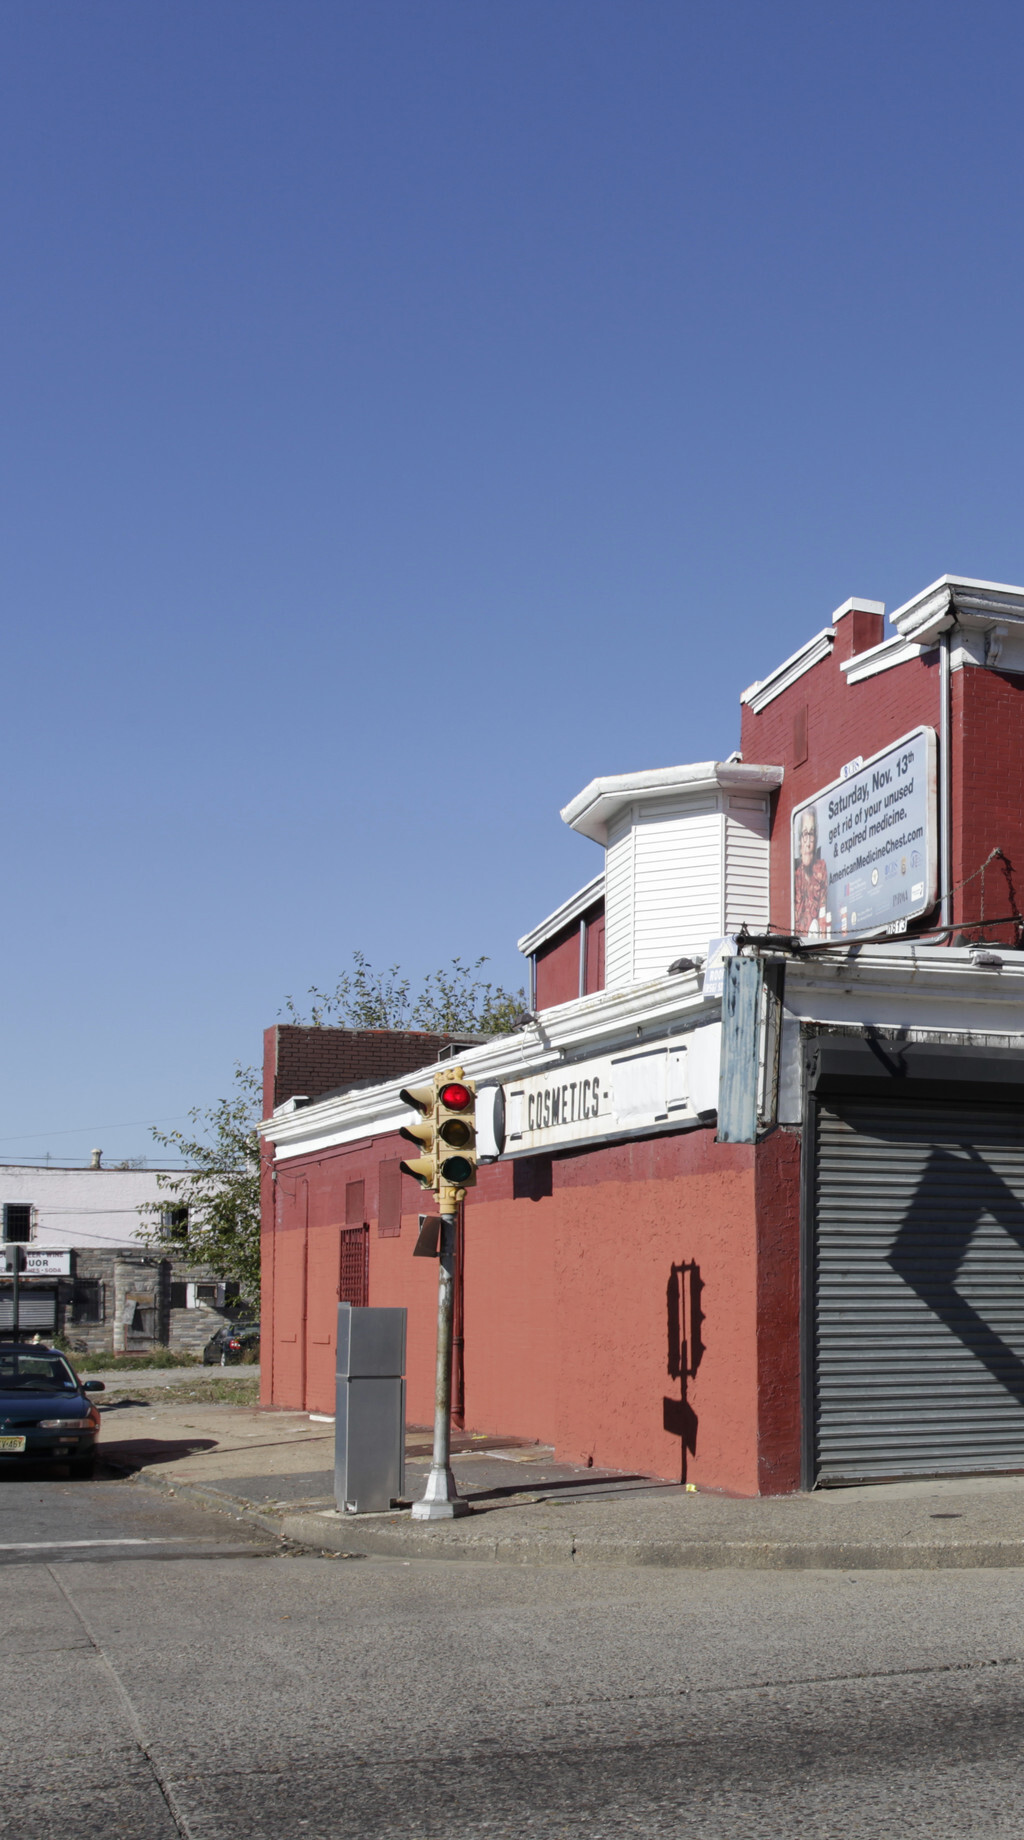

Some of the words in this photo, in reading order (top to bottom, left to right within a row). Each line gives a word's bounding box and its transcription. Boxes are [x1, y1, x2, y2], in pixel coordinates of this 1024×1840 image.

[828, 782, 869, 820] Saturday,
[872, 771, 893, 793] Nov.
[896, 751, 914, 777] 13th
[828, 826, 841, 845] get
[841, 816, 853, 833] rid
[854, 811, 864, 826] of
[864, 802, 882, 822] your
[884, 777, 914, 808] unused
[828, 825, 923, 886] AmericanMedicineChest.com
[833, 842, 839, 858] &
[840, 825, 867, 855] expired
[868, 807, 907, 838] medicine.
[528, 1076, 600, 1131] COSMETICS
